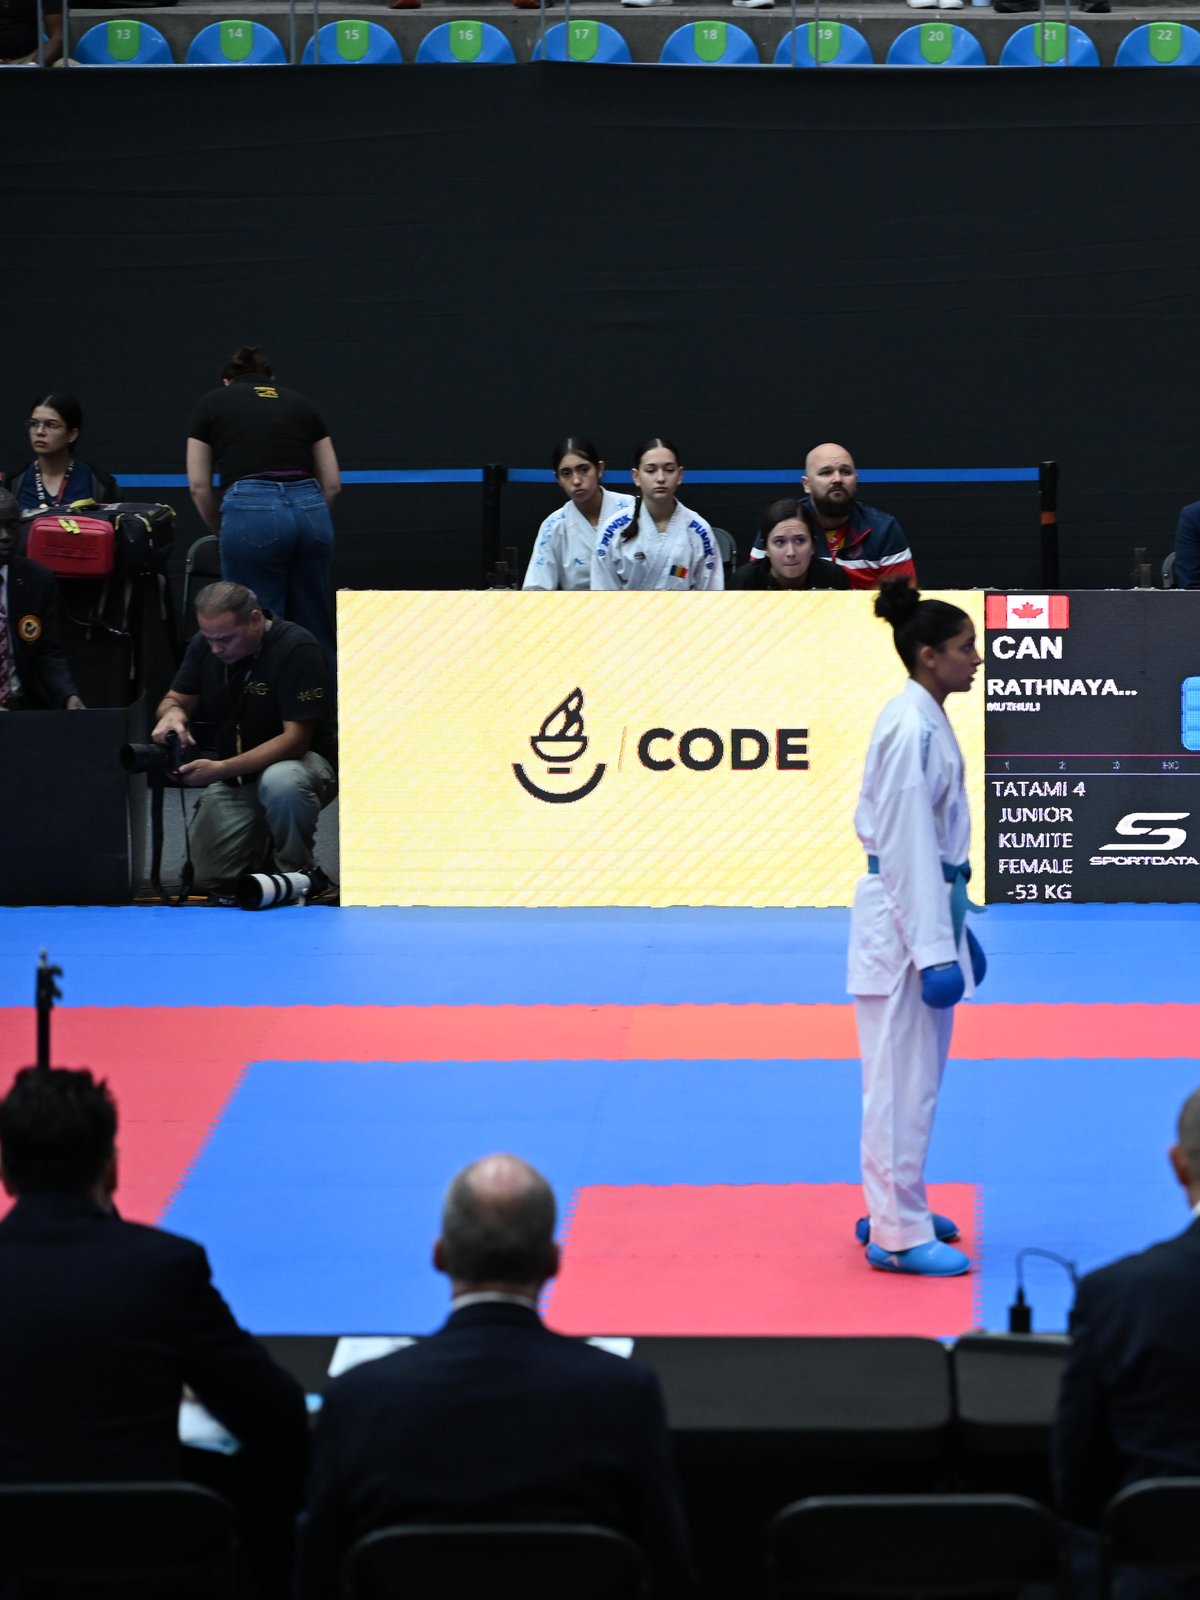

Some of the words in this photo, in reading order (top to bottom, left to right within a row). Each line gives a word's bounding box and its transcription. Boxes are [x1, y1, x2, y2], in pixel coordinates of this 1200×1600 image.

[117, 30, 130, 39] 13
[228, 29, 243, 38] 14
[345, 30, 359, 39] 15
[459, 30, 473, 40] 16
[575, 29, 589, 39] 17
[703, 30, 717, 40] 18
[818, 30, 832, 39] 19
[928, 31, 944, 41] 20
[1043, 30, 1056, 39] 21
[1157, 30, 1172, 40] 22
[601, 514, 632, 547] PUNOK
[688, 520, 714, 558] PUNOK
[992, 636, 1063, 659] CAN
[987, 679, 1138, 696] RATHNAYA...
[638, 728, 809, 771] CODE
[992, 781, 1068, 797] TATAMI
[1072, 781, 1086, 797] 4
[999, 807, 1073, 823] JUNIOR
[998, 833, 1073, 848] KUMITE
[1089, 856, 1199, 866] SPORTDATA
[998, 859, 1073, 874] FEMALE
[1006, 884, 1038, 900] -53
[1044, 884, 1072, 900] KG
